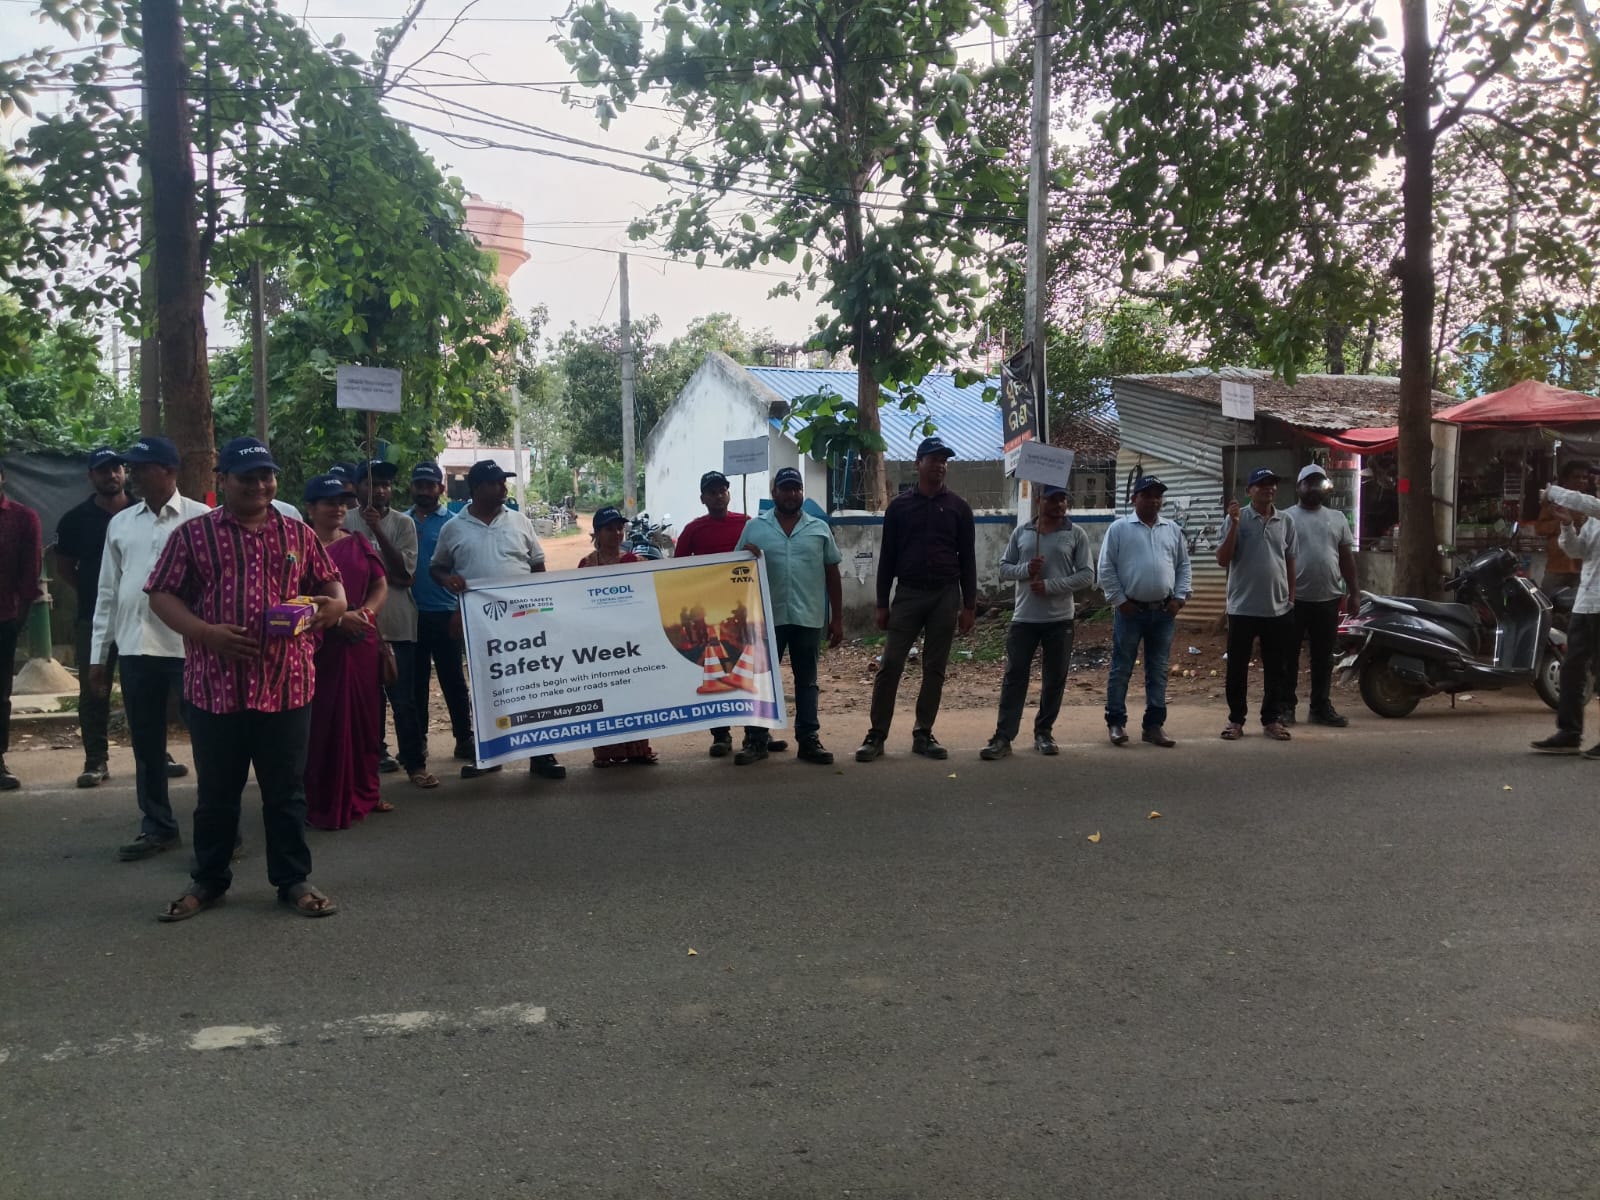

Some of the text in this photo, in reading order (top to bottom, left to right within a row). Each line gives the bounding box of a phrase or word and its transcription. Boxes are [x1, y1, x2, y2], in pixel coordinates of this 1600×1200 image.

[587, 585, 635, 596] TPCODL
[730, 576, 754, 584] TATA
[487, 630, 547, 656] Road
[490, 640, 642, 680] Safety Week
[492, 687, 513, 698] Safer
[516, 682, 541, 692] roads
[542, 677, 568, 687] begin
[570, 673, 589, 683] with
[591, 666, 631, 679] informed
[493, 678, 631, 707] Choose to make our roads safer
[553, 707, 573, 718] May
[575, 702, 599, 713] 2026
[510, 701, 754, 747] NAYAGARH ELECTRICAL DIVISION
